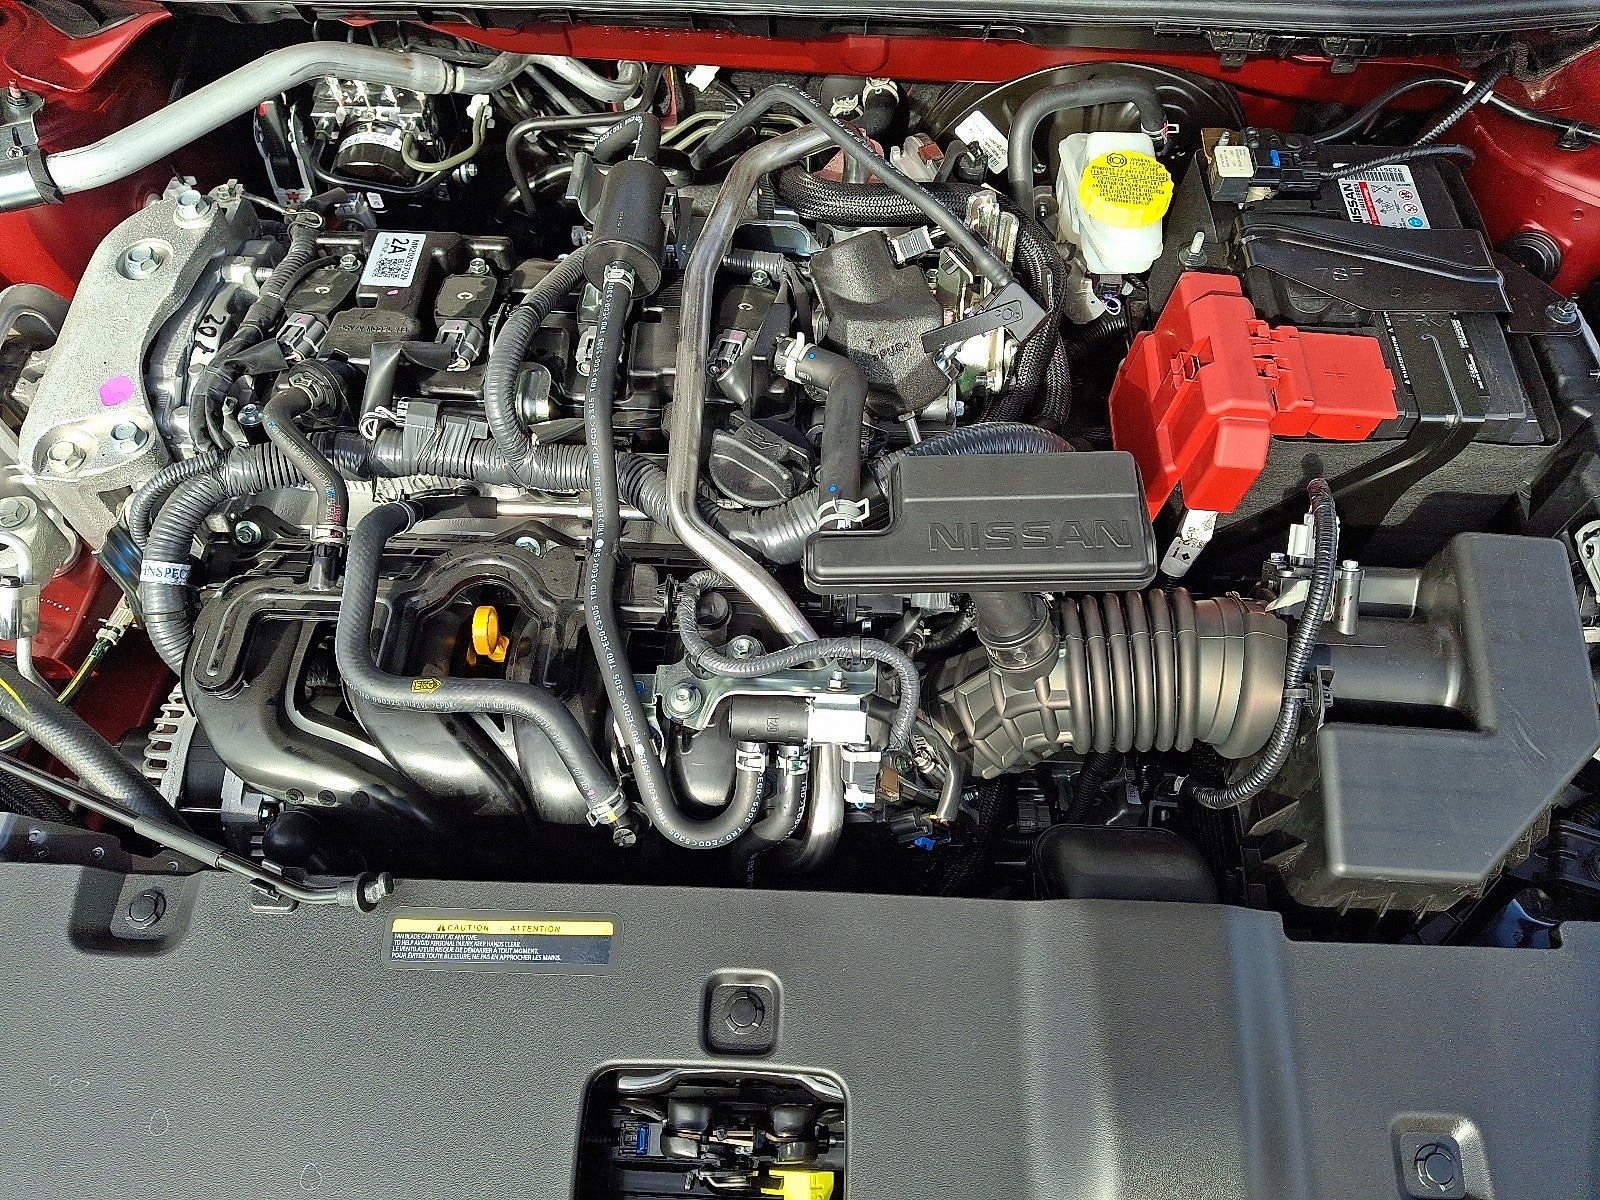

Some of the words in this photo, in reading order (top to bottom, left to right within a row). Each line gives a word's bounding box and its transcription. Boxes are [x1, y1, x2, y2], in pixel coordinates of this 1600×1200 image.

[388, 237, 409, 255] 2A
[928, 520, 1132, 551] NISSAN
[447, 924, 490, 932] CAUTION
[510, 925, 561, 933] ATTENTION
